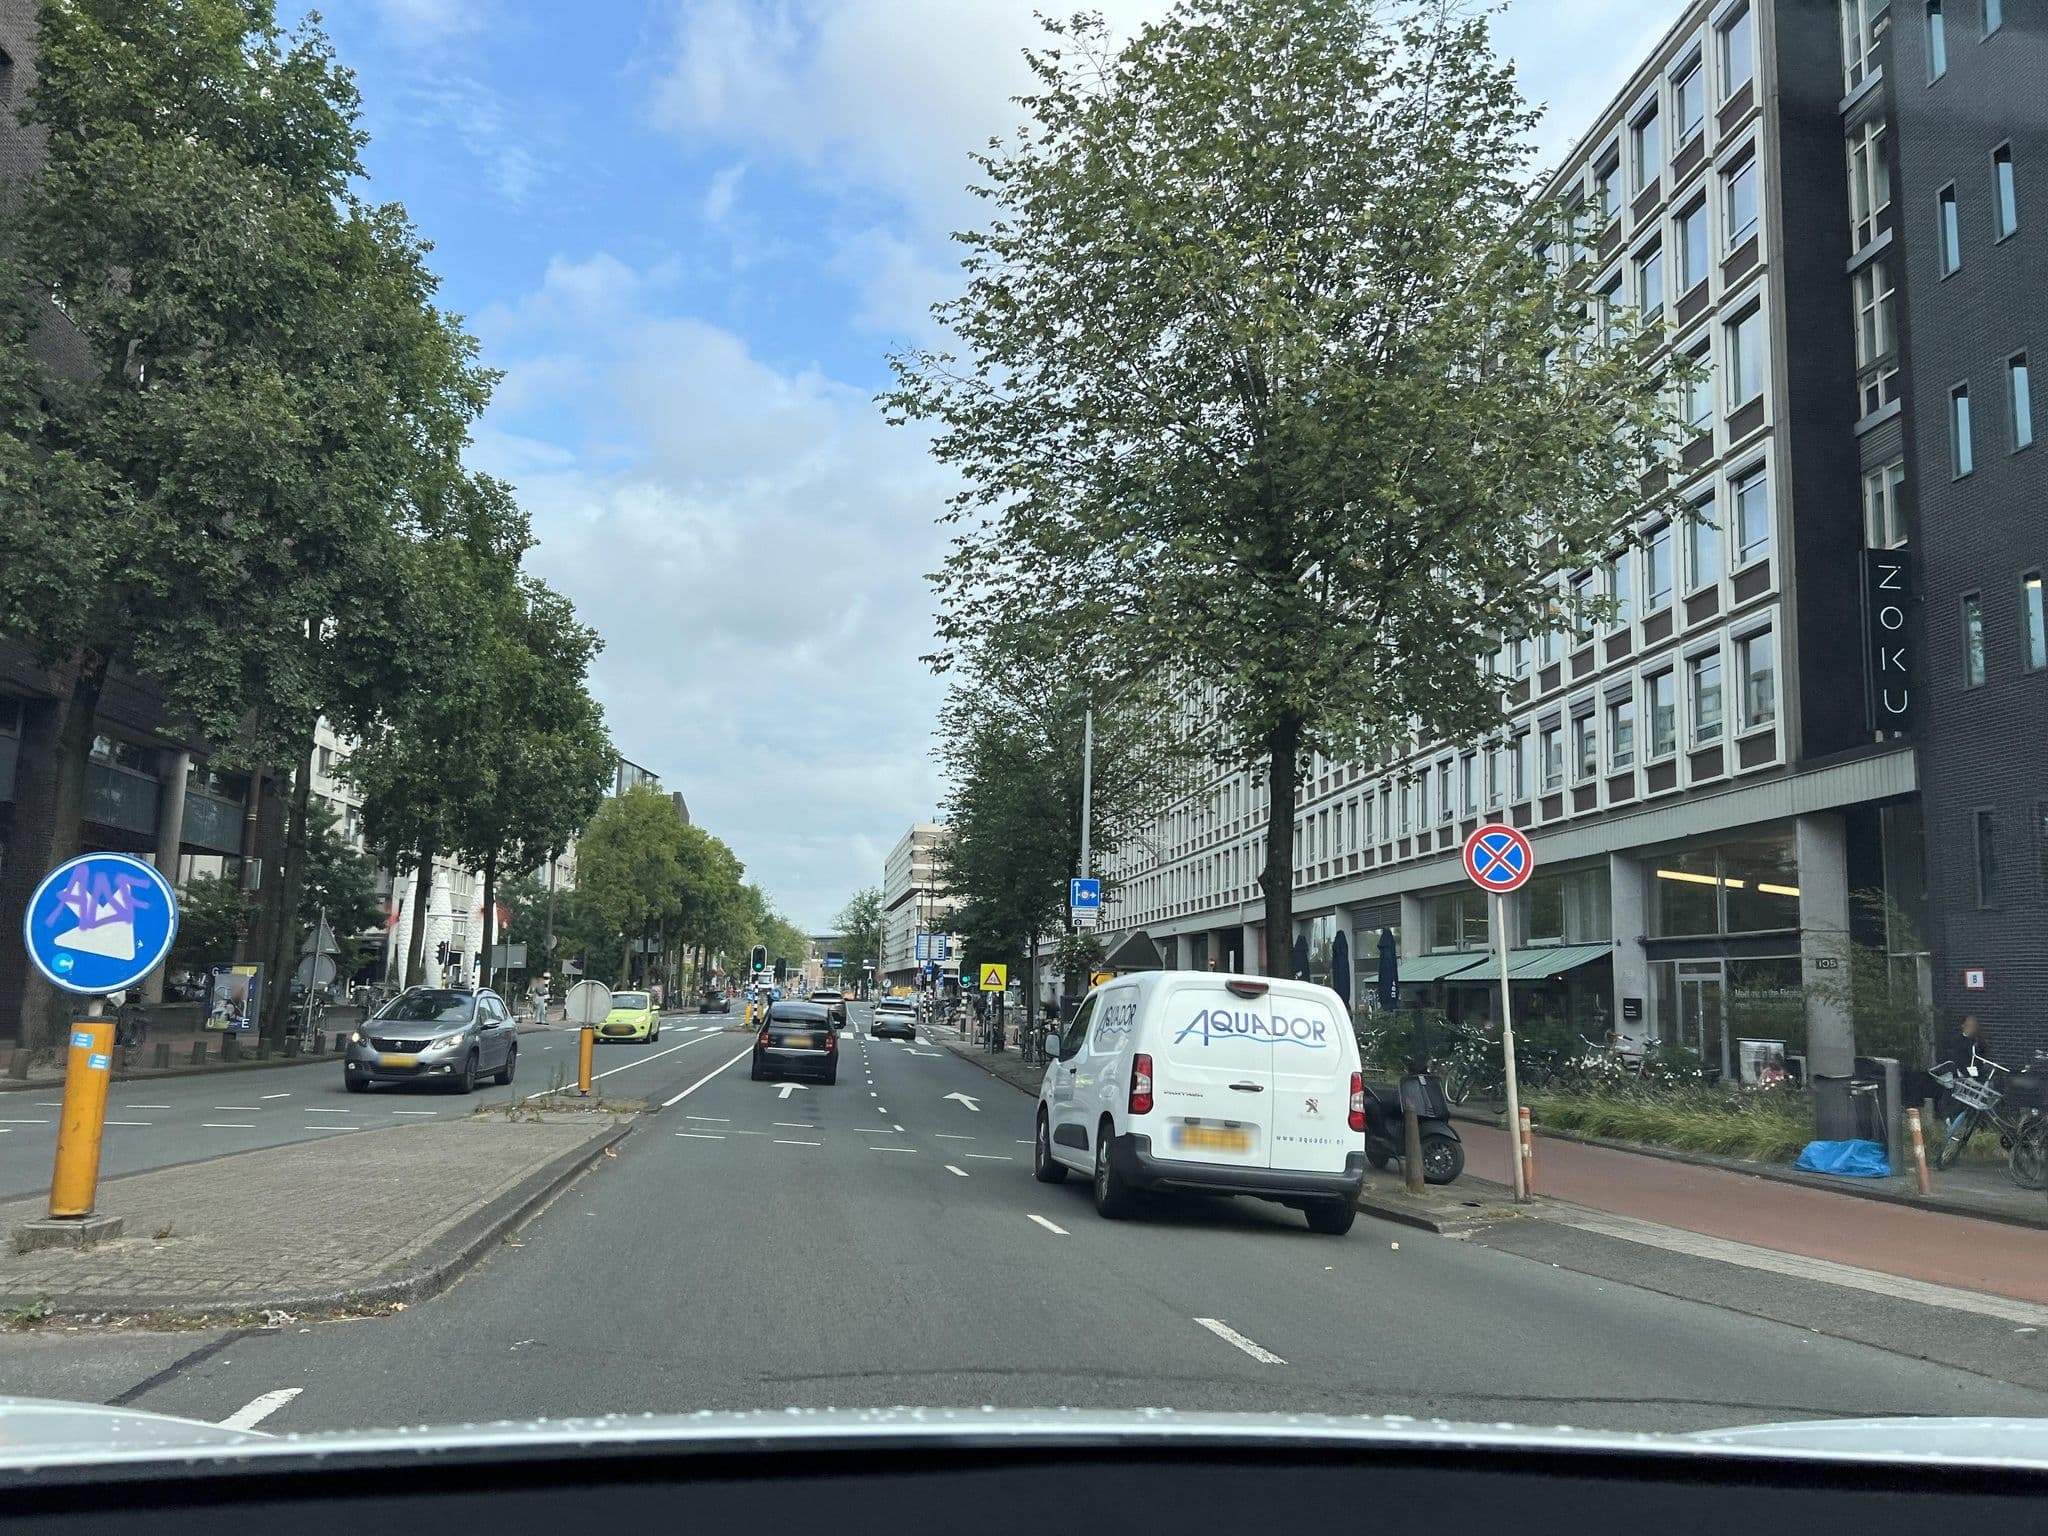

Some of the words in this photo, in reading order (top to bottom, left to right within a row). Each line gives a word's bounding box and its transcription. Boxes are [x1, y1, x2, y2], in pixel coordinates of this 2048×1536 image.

[1877, 564, 1909, 714] ZOKU
[1818, 959, 1837, 968] 105
[1174, 1009, 1326, 1046] AQUADOR
